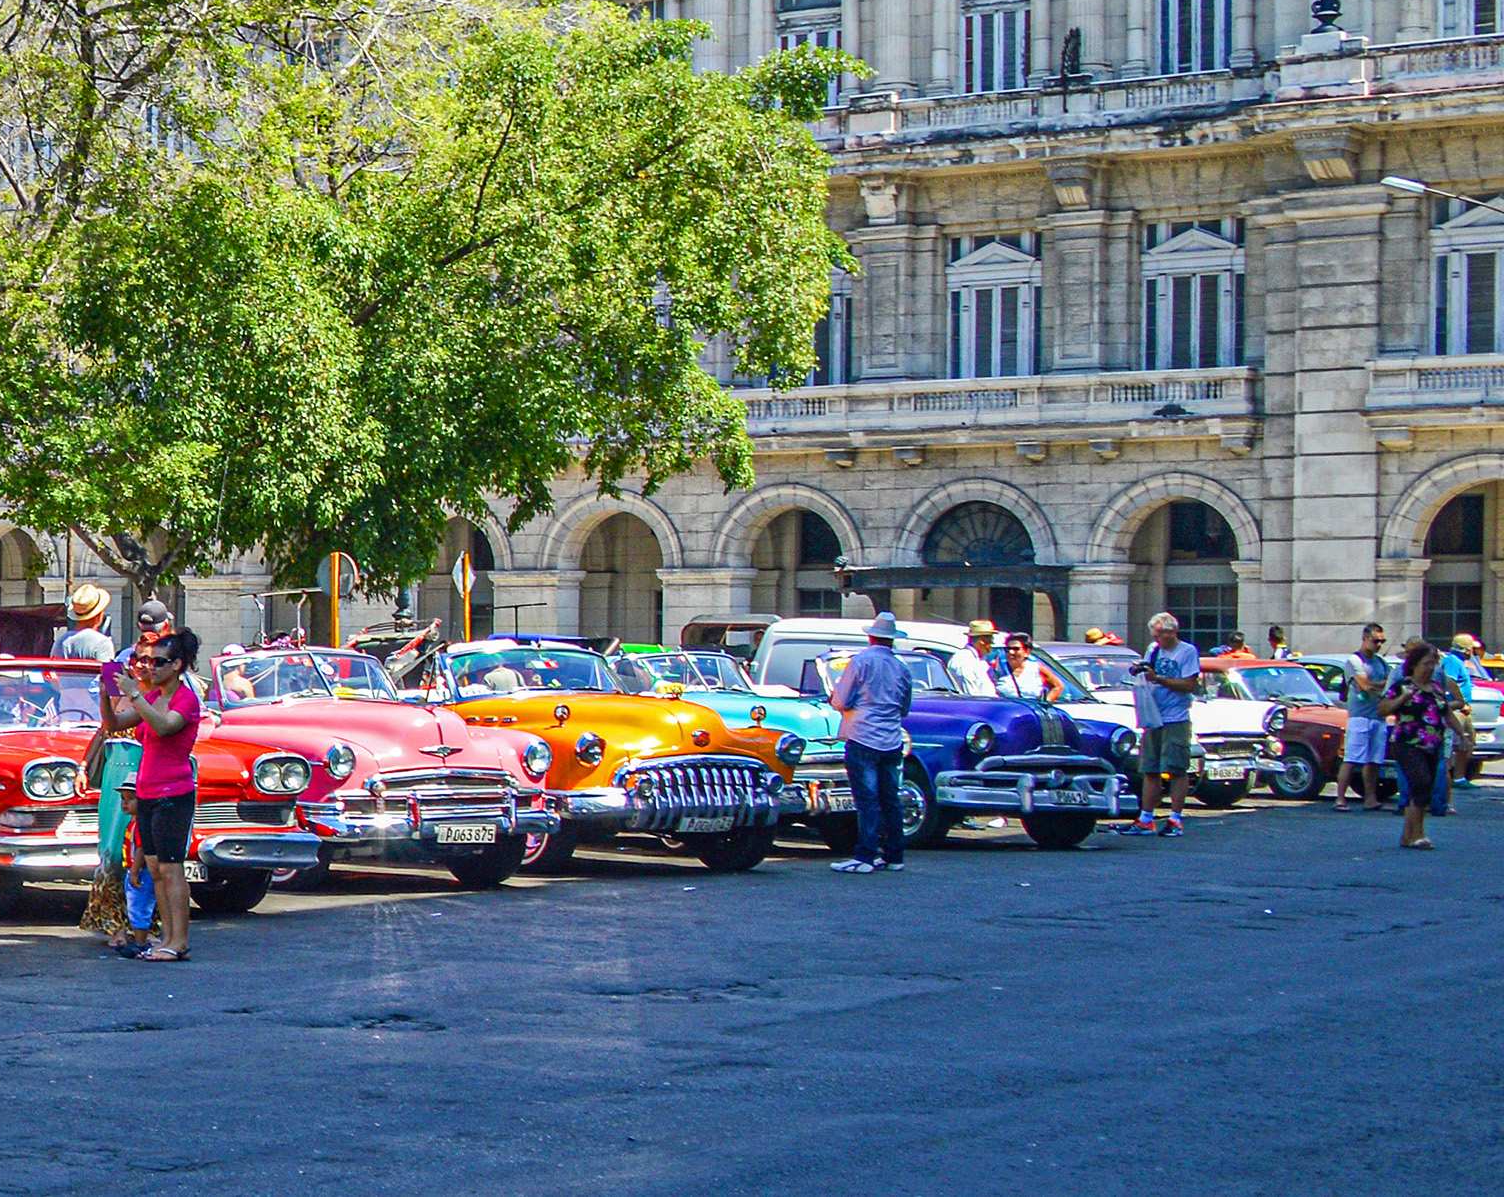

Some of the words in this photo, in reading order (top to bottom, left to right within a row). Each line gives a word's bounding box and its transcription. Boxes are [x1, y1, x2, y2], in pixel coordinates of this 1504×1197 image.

[445, 827, 452, 841] P
[453, 829, 472, 842] 063
[474, 828, 494, 842] 875
